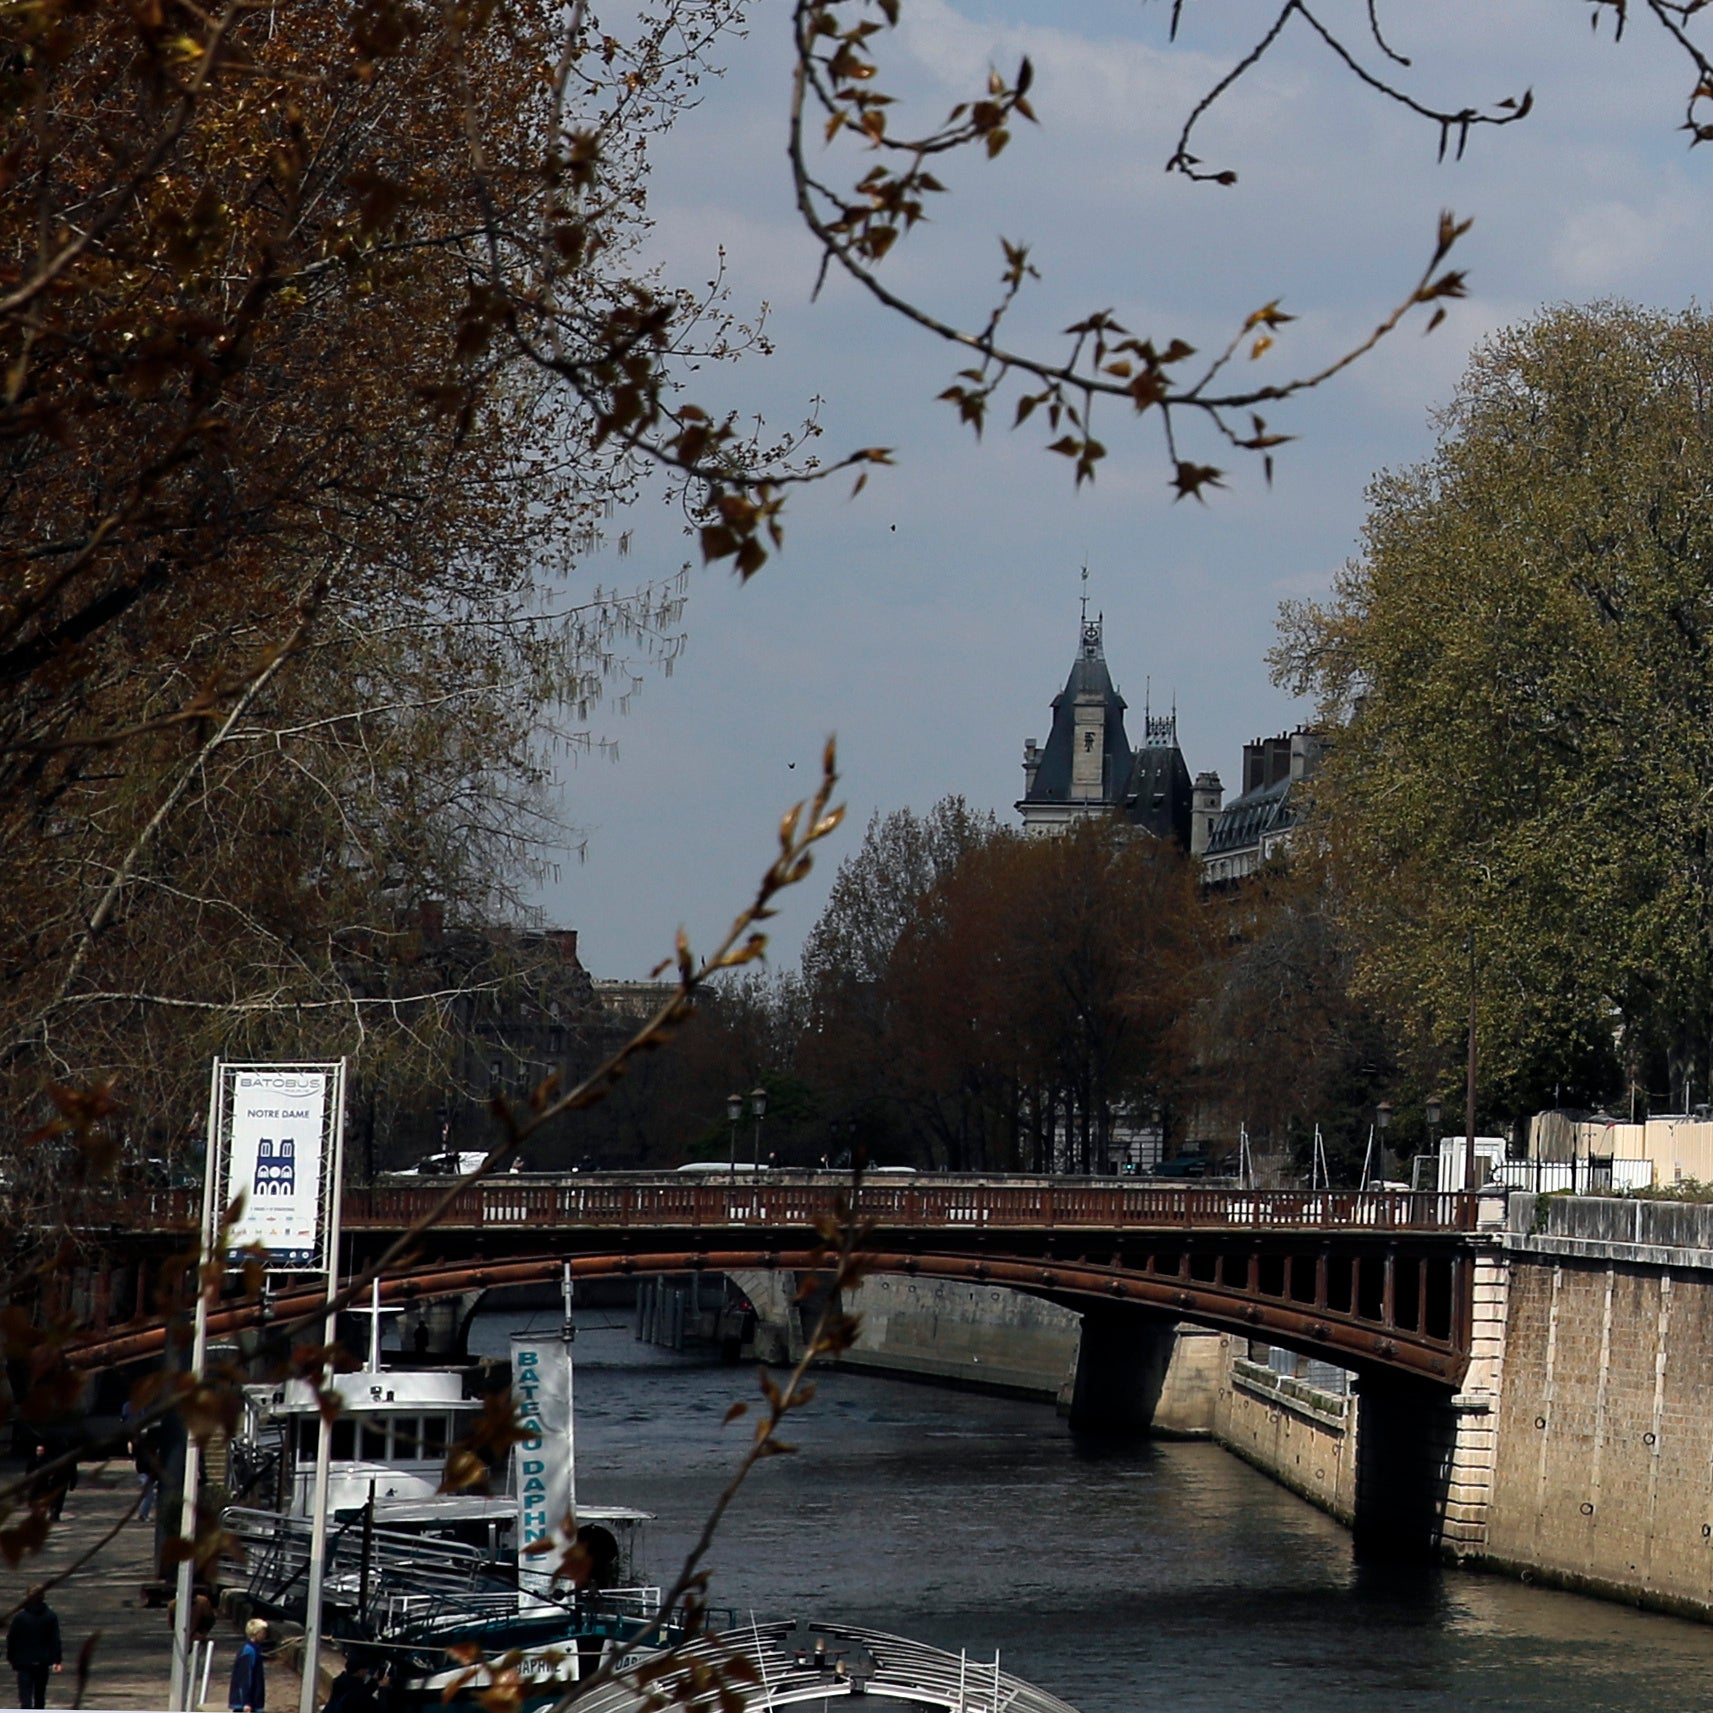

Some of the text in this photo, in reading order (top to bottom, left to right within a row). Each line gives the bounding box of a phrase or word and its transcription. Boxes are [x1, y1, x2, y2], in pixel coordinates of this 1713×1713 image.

[240, 1078, 320, 1088] BATOBUS
[247, 1109, 310, 1119] NOTRE DAME
[517, 1351, 542, 1451] BATEAU
